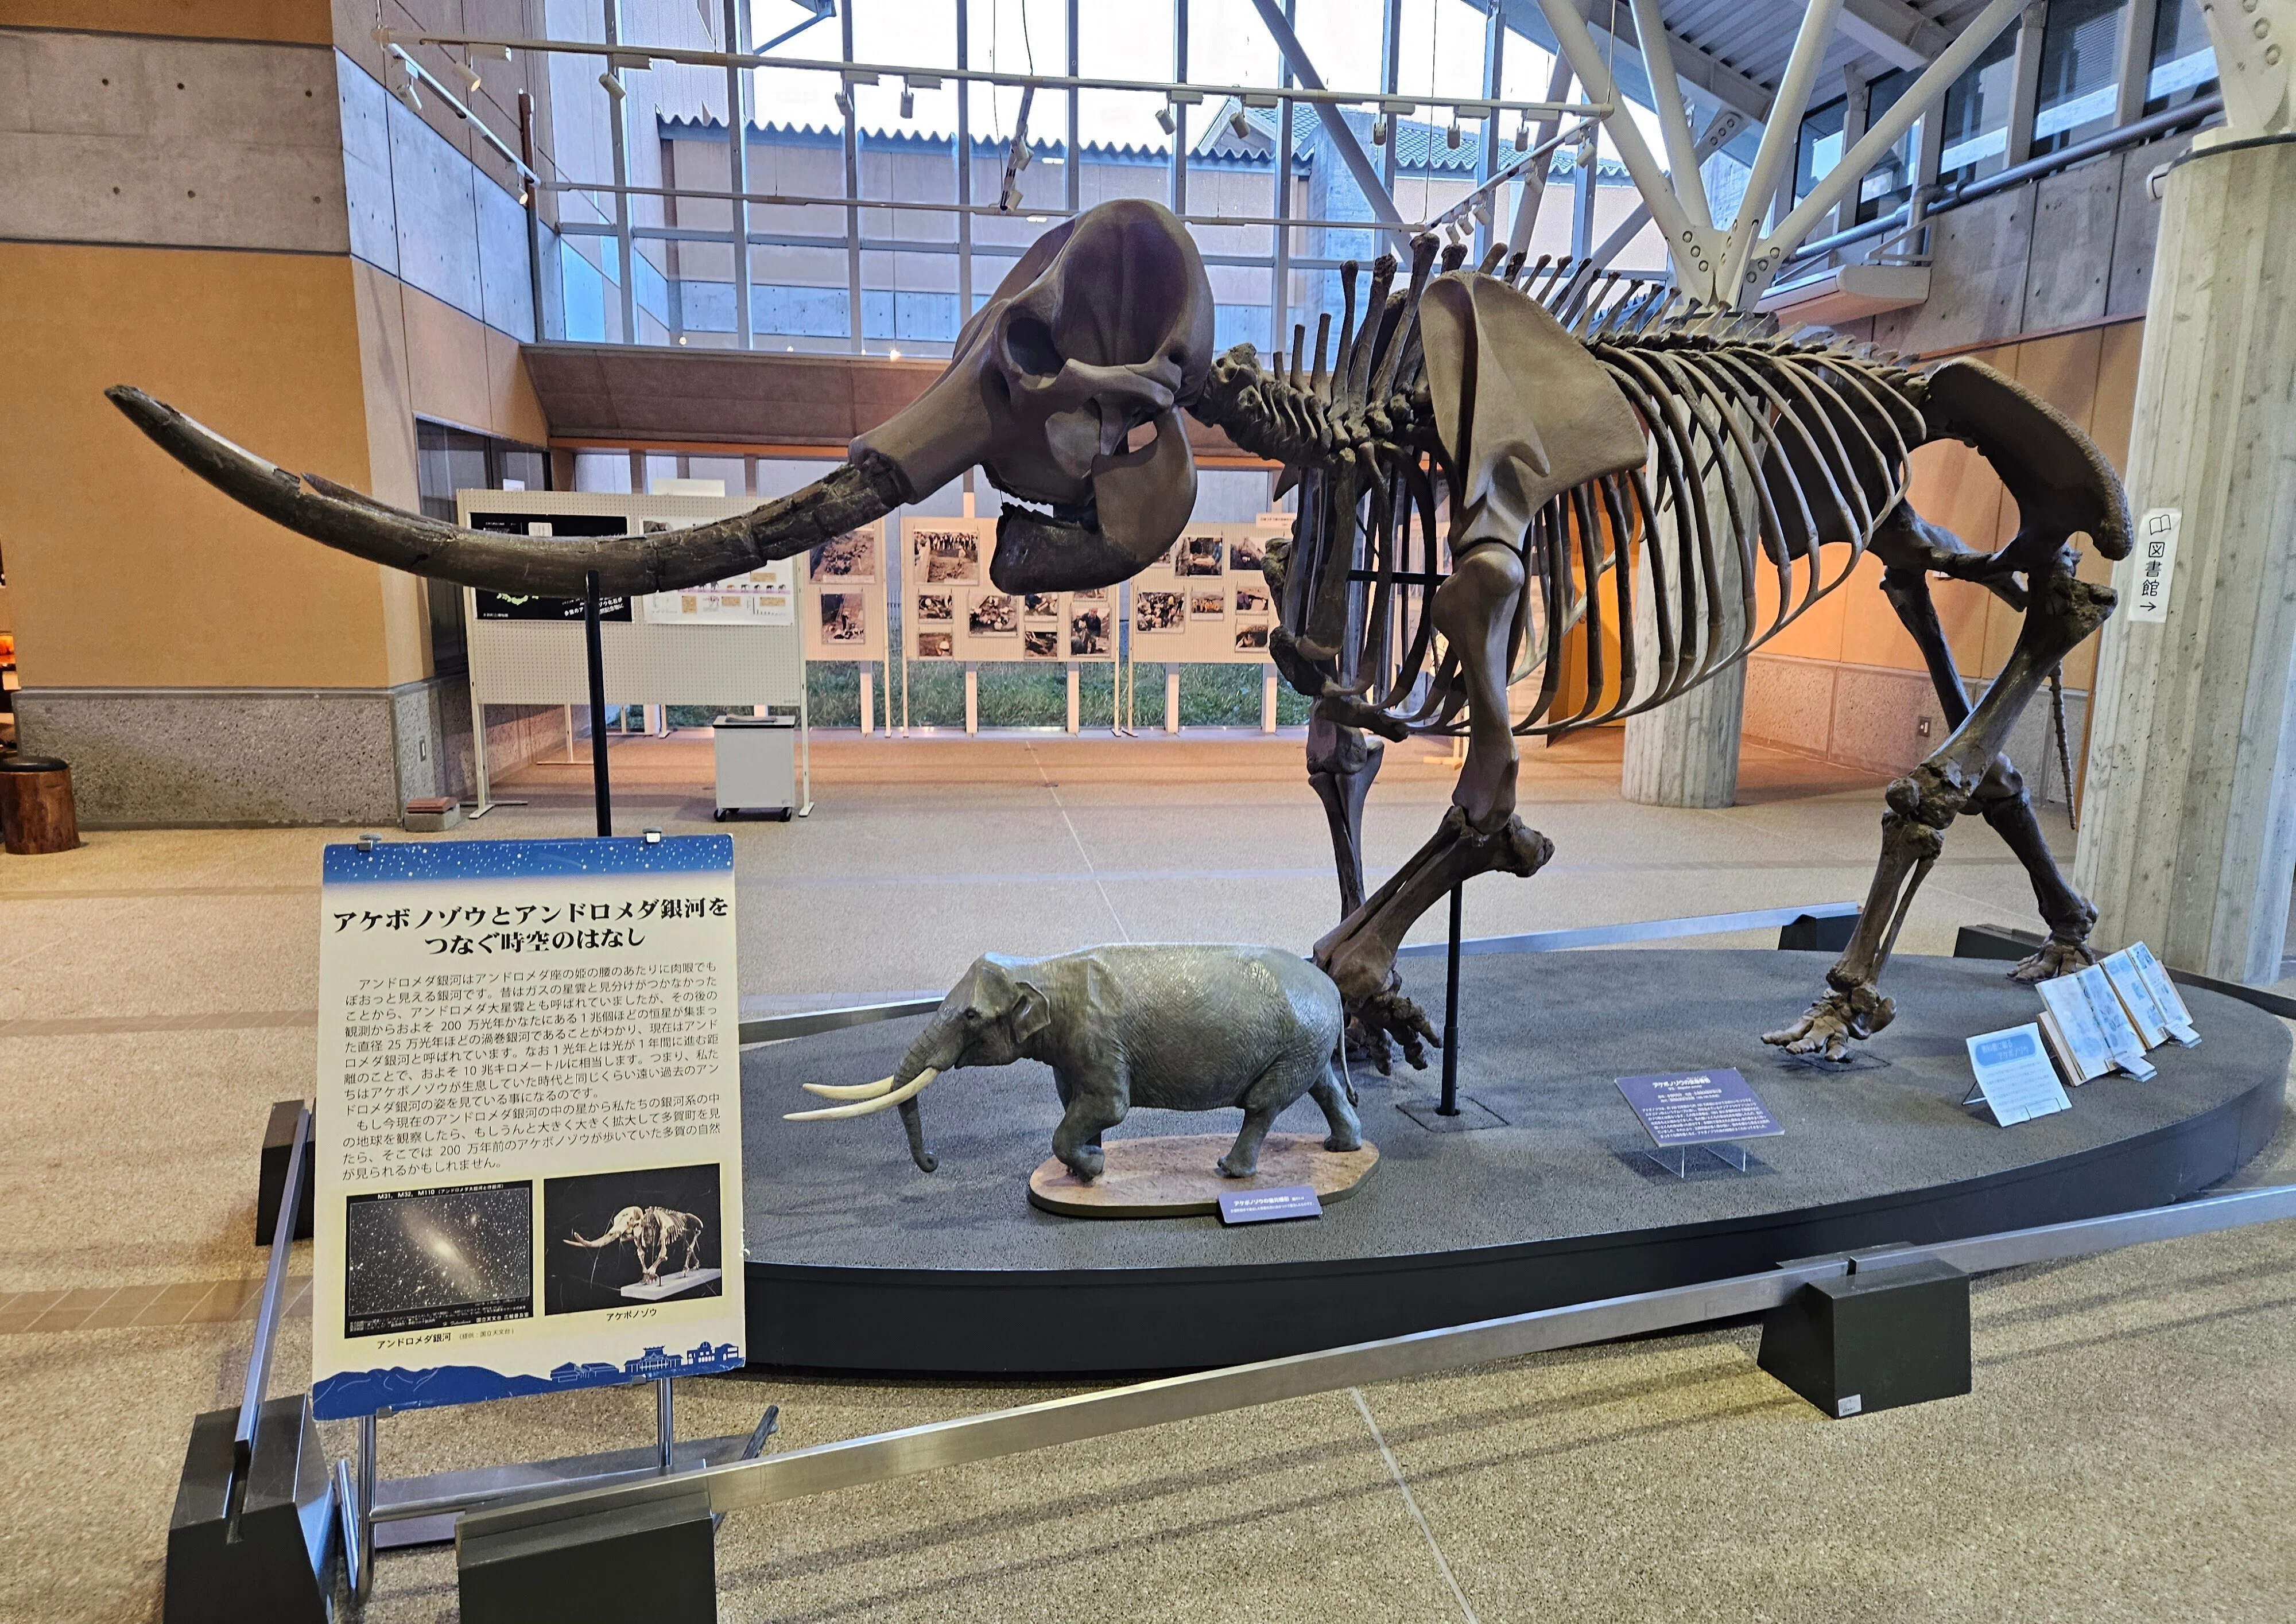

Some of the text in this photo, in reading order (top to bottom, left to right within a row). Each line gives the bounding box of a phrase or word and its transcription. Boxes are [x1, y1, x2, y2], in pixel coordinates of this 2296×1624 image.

[2142, 541, 2165, 596] 図書館
[333, 896, 729, 933] アケボノゾウとアンドロメダ銀河を
[424, 927, 646, 955] つなぐ時空のはなし
[607, 1308, 657, 1322] アケボノゾウ
[377, 1332, 452, 1350] アンドロメダ銀河
